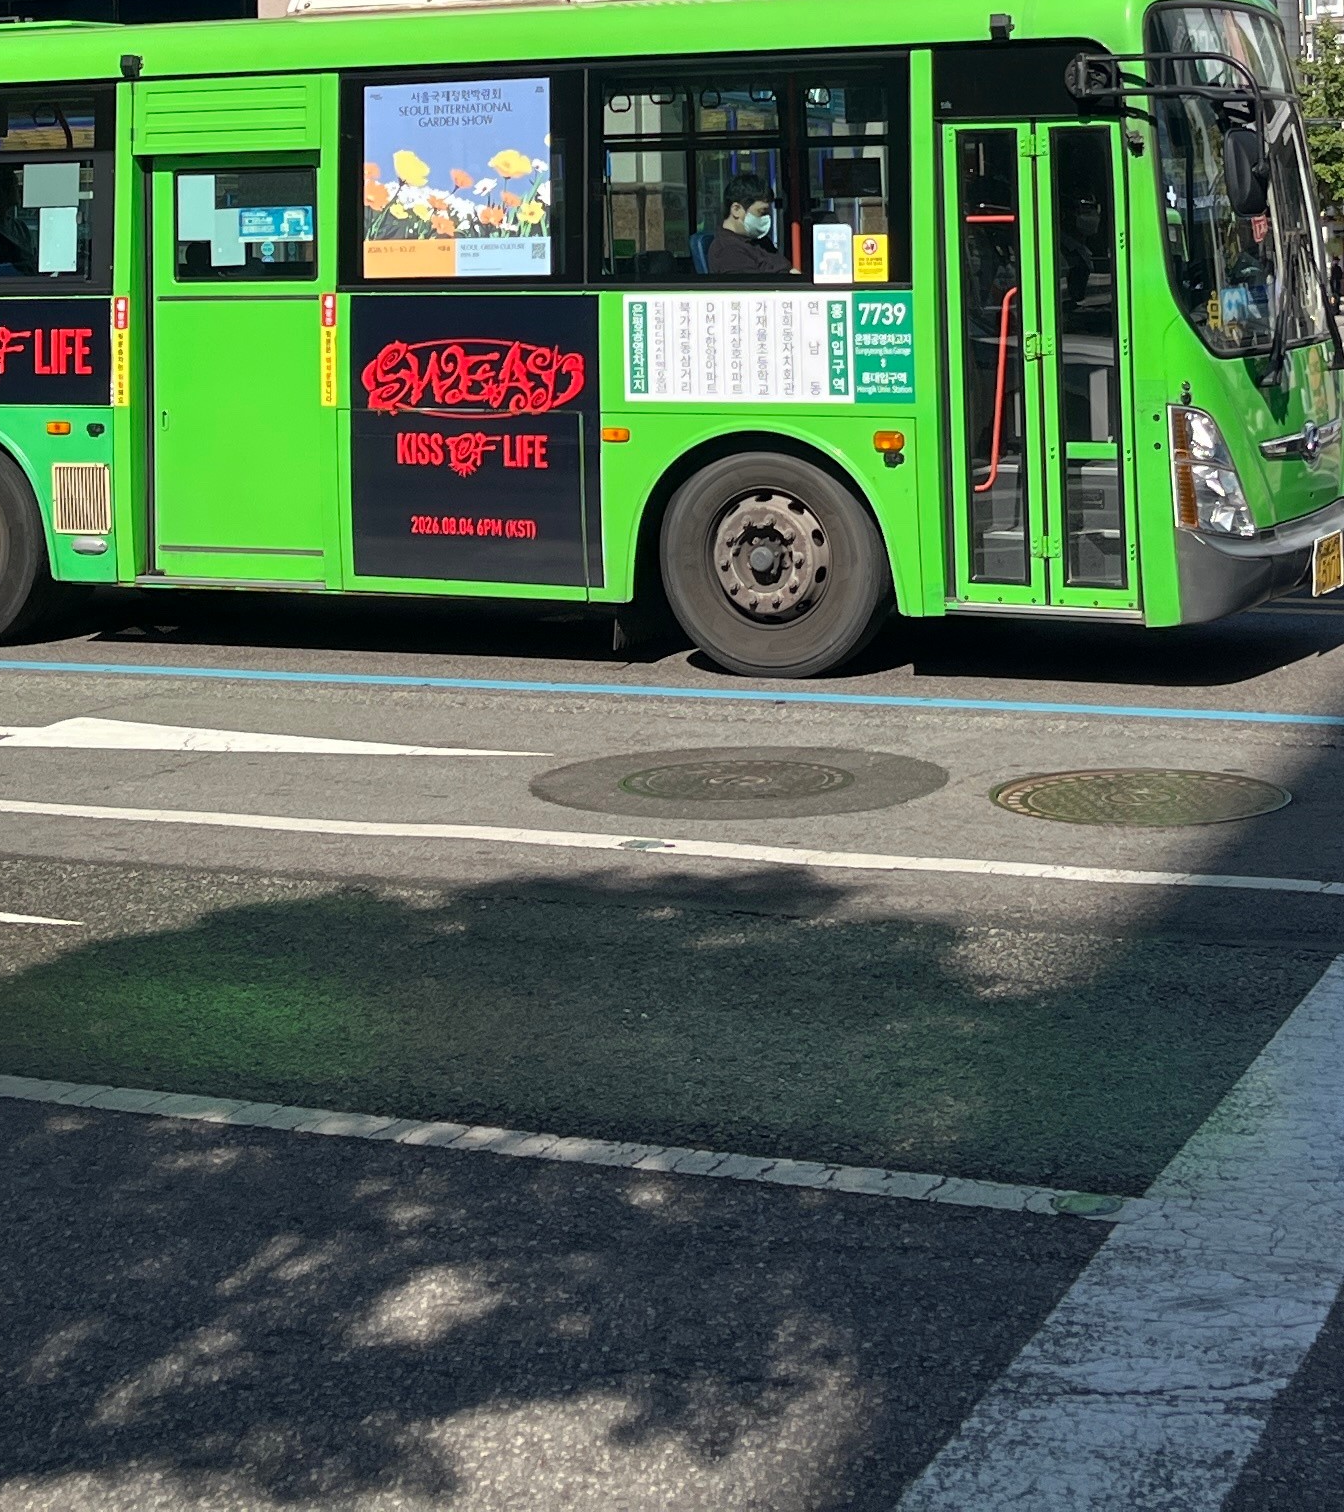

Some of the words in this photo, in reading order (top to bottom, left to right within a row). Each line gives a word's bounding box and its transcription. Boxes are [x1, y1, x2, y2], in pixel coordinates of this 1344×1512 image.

[398, 106, 431, 117] SEOUL
[433, 102, 513, 115] INTERNATIONAL
[418, 116, 460, 128] GARDEN
[462, 114, 494, 127] SHOW
[858, 302, 906, 325] 7739
[830, 303, 845, 393] 홍대입구역
[854, 333, 912, 346] 은평공영차고지
[34, 328, 93, 375] LIFE
[862, 372, 908, 385] 홍대입구역
[396, 432, 444, 465] KISS
[503, 434, 548, 469] LIFE
[477, 517, 502, 537] 6PM
[504, 519, 537, 540] (KST)
